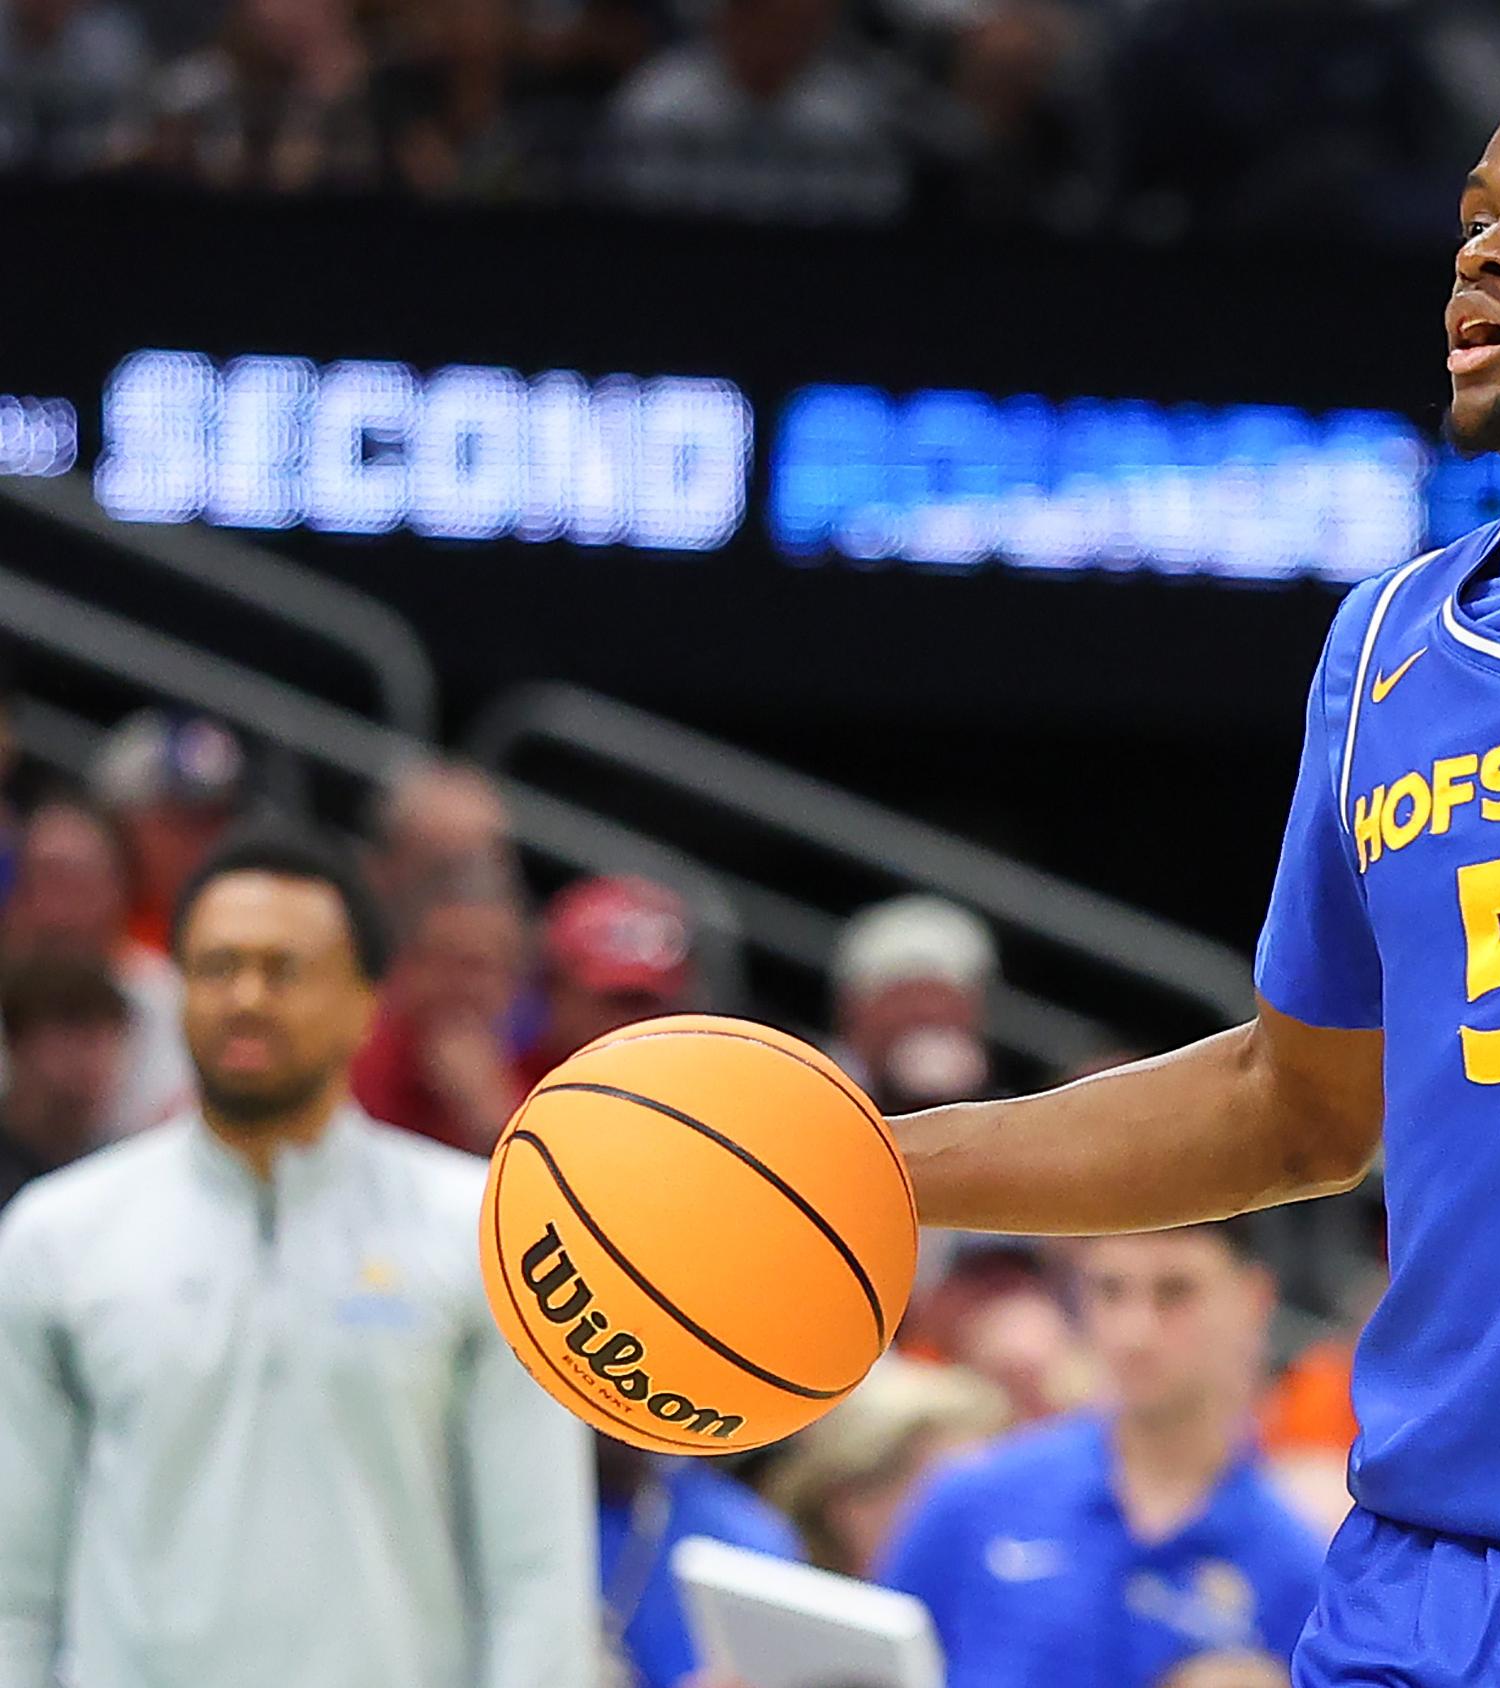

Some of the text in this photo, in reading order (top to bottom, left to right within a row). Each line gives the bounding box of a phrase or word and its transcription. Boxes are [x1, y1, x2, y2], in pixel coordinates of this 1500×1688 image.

[95, 348, 754, 550] SECOND
[520, 1220, 748, 1439] Wilson
[562, 1355, 633, 1413] EVO NXT
